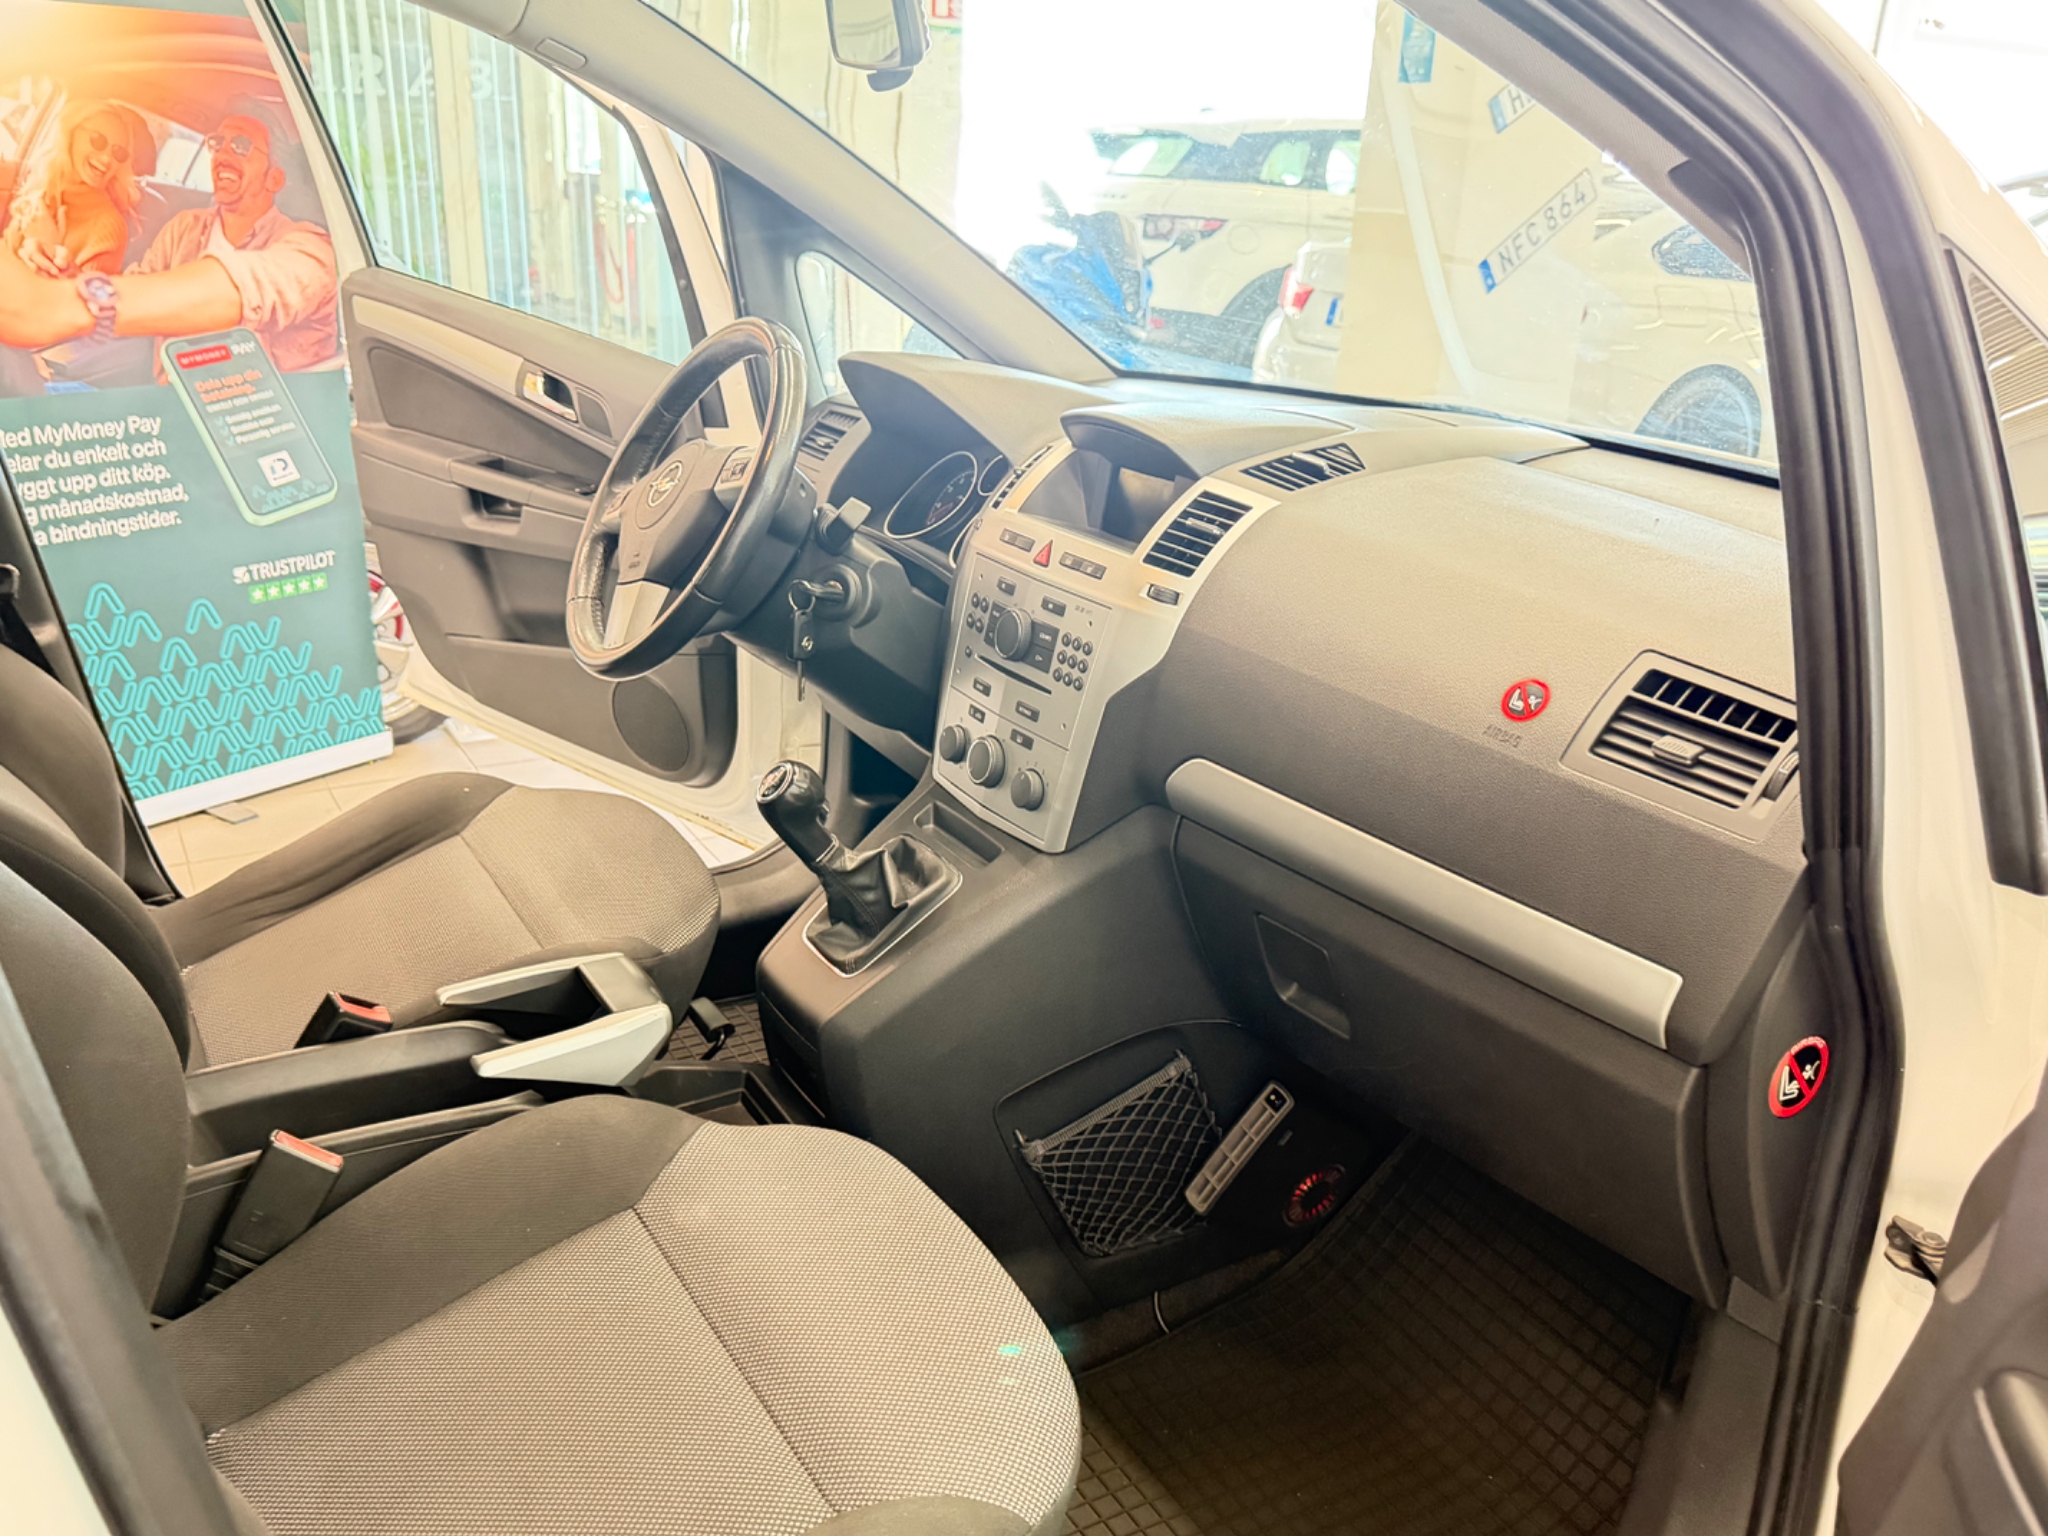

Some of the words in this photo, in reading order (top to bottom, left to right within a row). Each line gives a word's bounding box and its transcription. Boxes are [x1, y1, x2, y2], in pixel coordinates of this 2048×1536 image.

[1498, 222, 1541, 274] NFC
[1543, 181, 1586, 232] 864
[230, 341, 257, 355] PAY
[0, 427, 33, 449] ed
[33, 420, 126, 447] MyMoney
[127, 415, 162, 436] Pay
[7, 453, 42, 474] elar
[44, 449, 72, 470] du
[73, 442, 132, 467] enkelt
[131, 438, 168, 459] och
[59, 473, 98, 496] upp
[99, 466, 132, 488] ditt
[132, 462, 172, 484] köp.
[25, 505, 40, 527] g
[34, 529, 49, 546] a
[49, 509, 183, 545] bindningstider.
[249, 550, 337, 581] TRUSTPILOT
